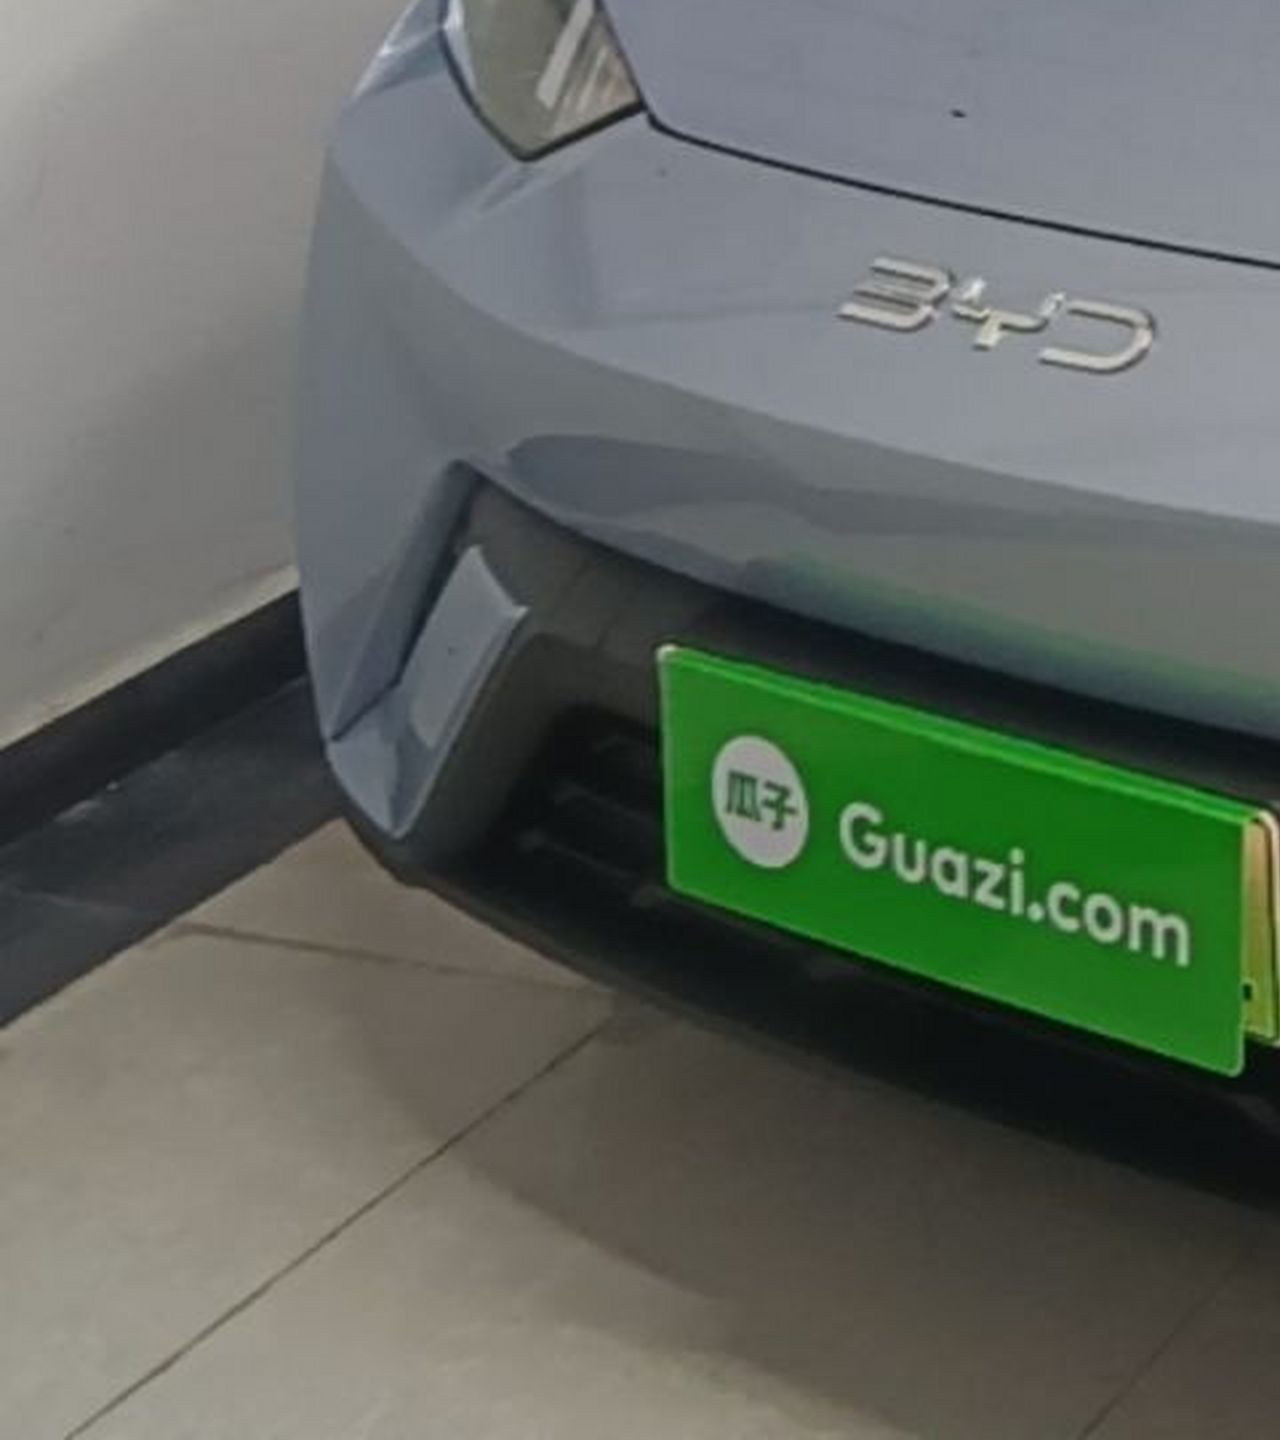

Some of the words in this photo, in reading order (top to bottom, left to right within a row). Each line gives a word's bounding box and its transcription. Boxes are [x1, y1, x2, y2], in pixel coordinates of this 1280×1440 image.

[837, 256, 1155, 375] BYD
[726, 769, 798, 832] 瓜子
[838, 801, 1191, 968] Guazi.com
